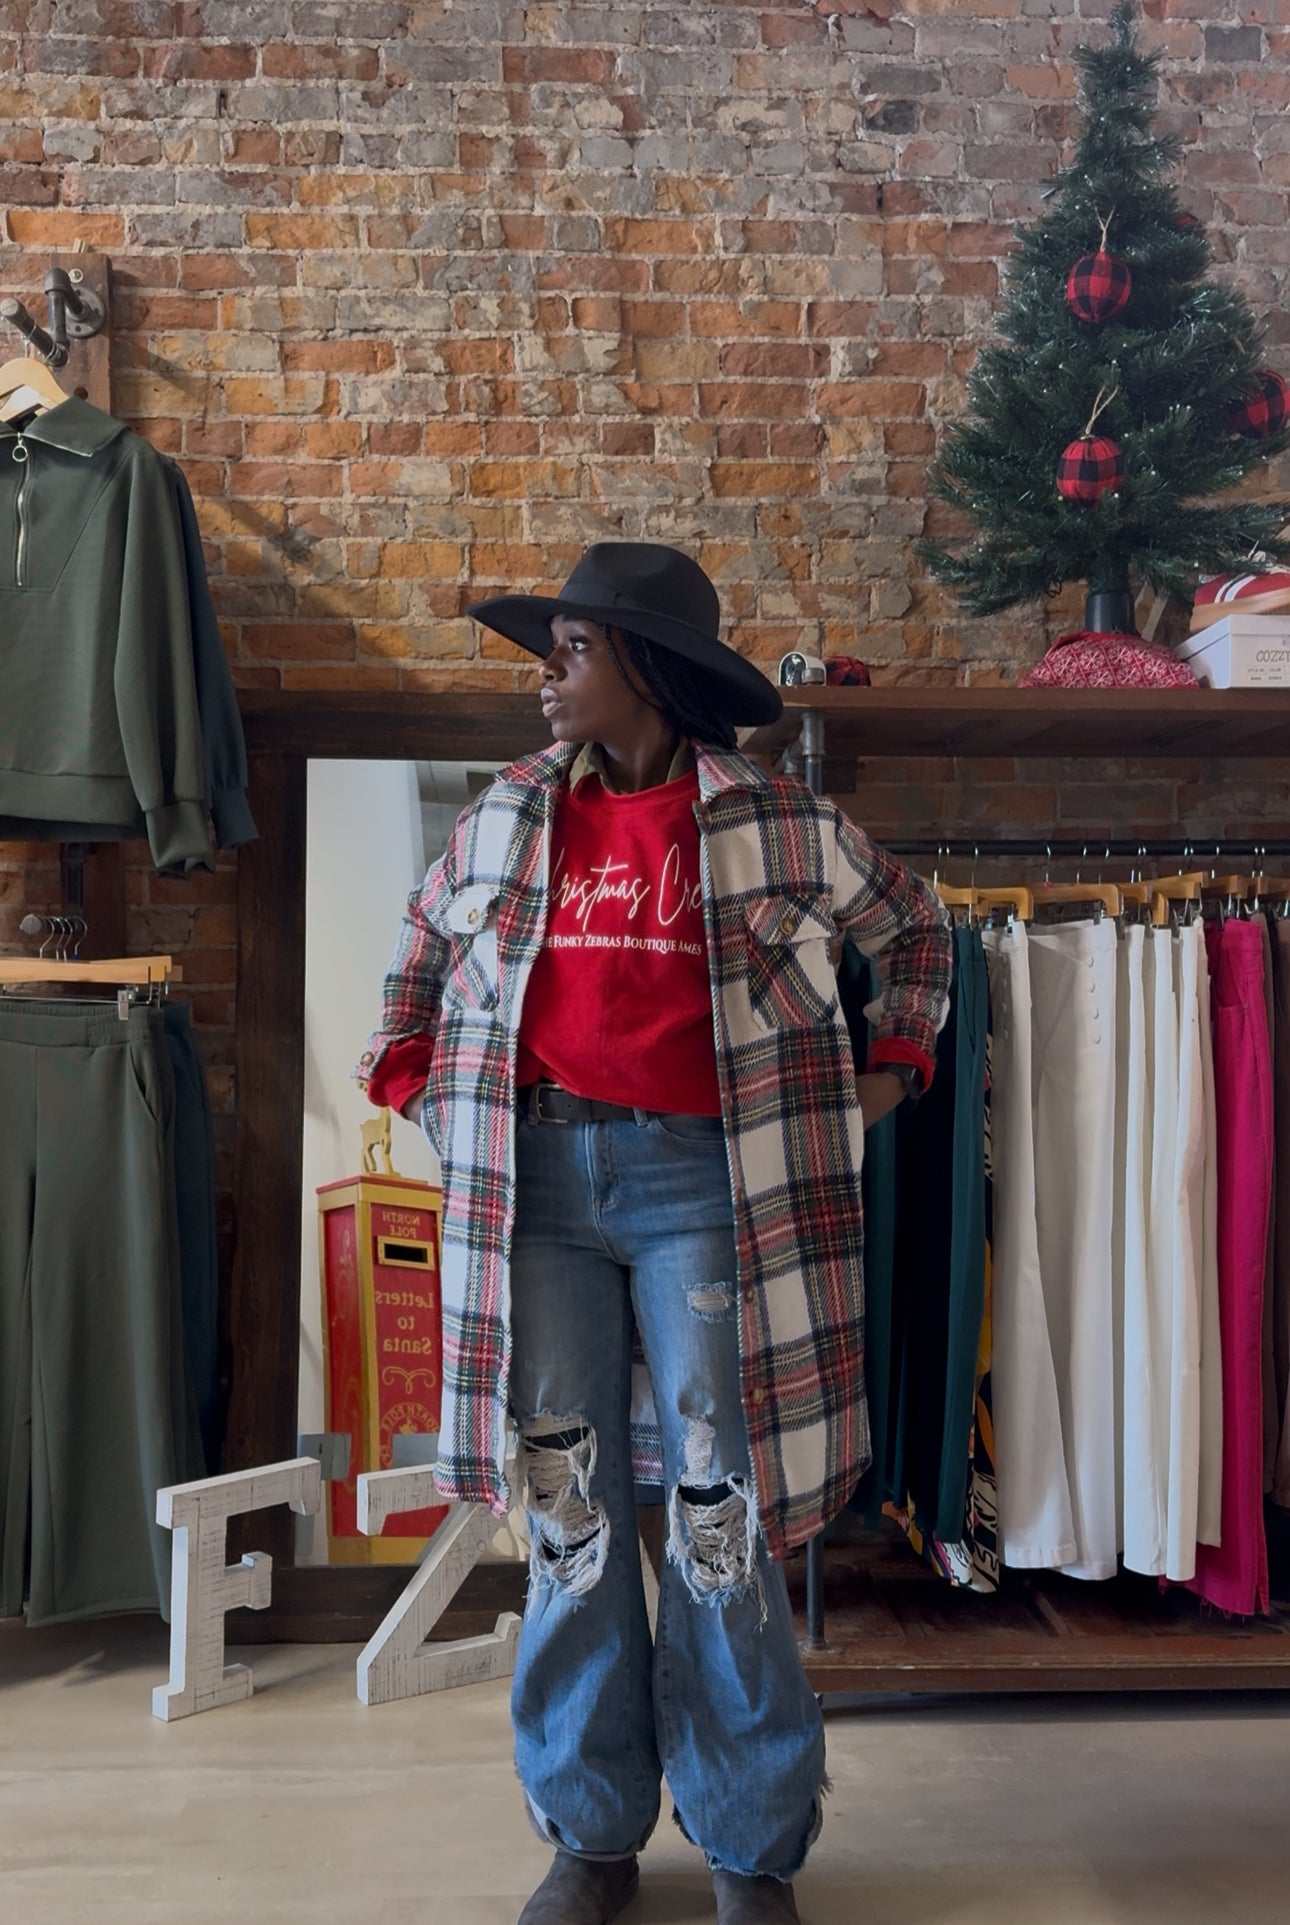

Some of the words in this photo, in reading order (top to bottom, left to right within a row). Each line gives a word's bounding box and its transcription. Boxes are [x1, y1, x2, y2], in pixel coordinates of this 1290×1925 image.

[549, 847, 651, 933] hristmas
[657, 843, 703, 926] Cre
[553, 935, 584, 949] FUNKY
[585, 934, 622, 949] ZEBRAS
[624, 935, 677, 955] BOUTIQUE
[678, 939, 702, 956] AMES
